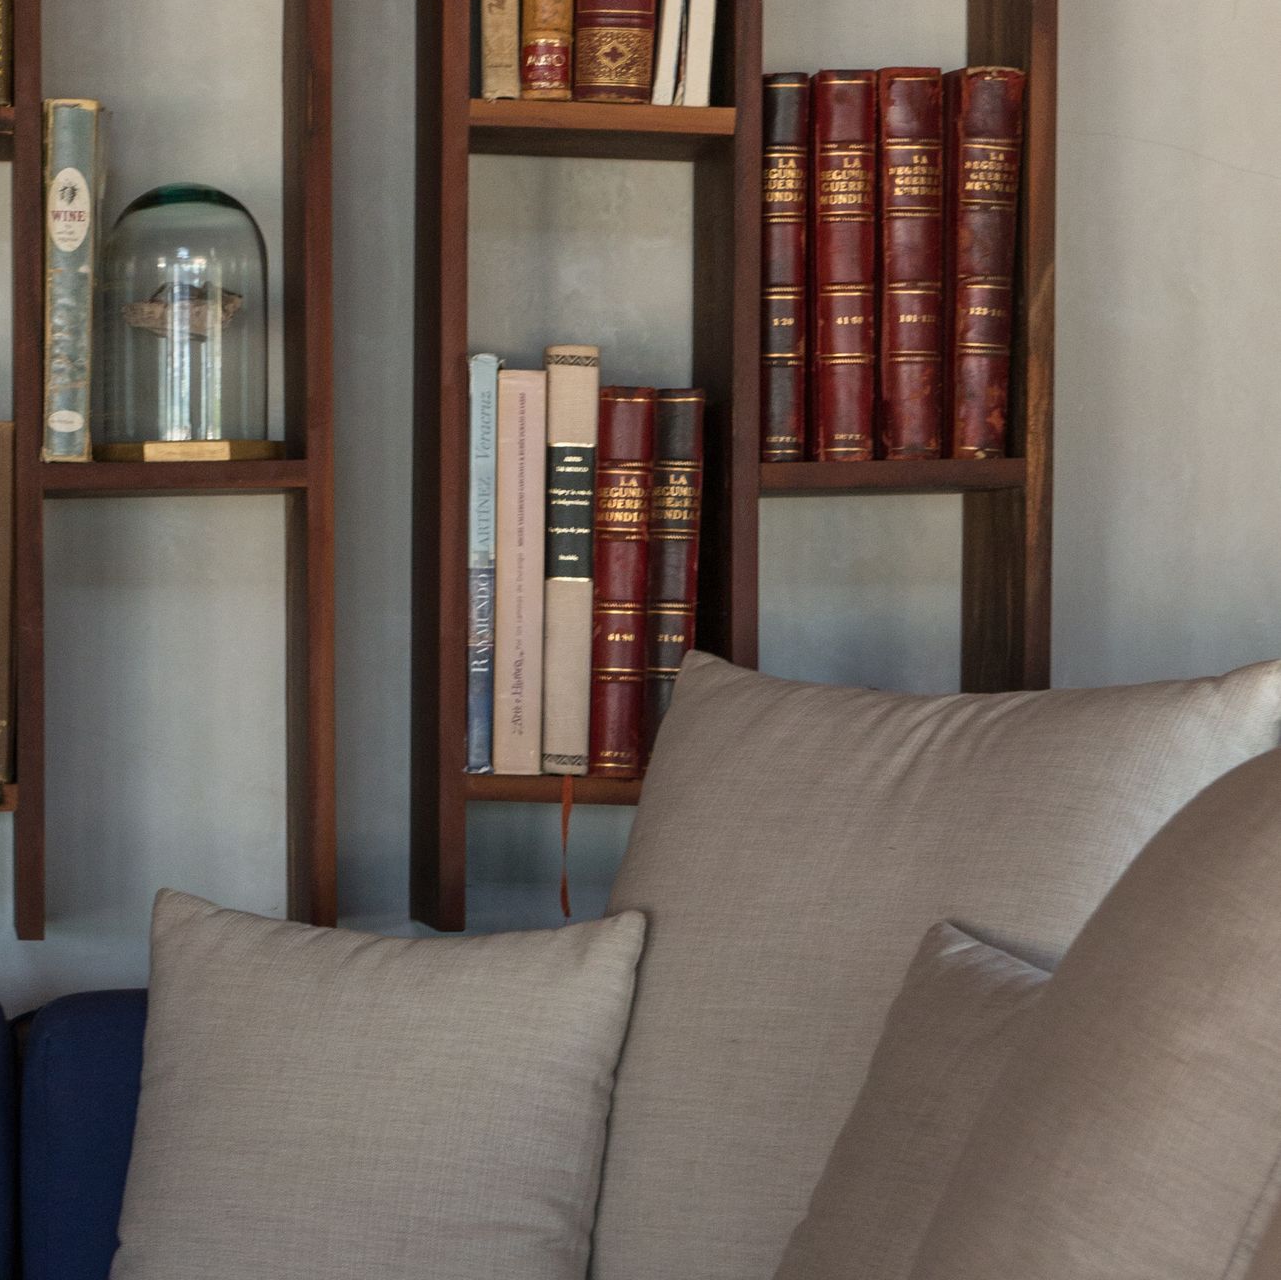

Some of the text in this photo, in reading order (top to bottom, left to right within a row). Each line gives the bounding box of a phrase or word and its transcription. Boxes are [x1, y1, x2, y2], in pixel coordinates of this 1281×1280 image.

[912, 154, 928, 164] LA
[989, 151, 1005, 161] LA
[778, 158, 797, 169] LA
[843, 157, 862, 168] LA
[51, 210, 86, 222] WINE
[619, 476, 638, 487] LA
[669, 474, 688, 485] LA
[470, 390, 493, 673] RAYMUNDO ARTÍNEZ Veracruz
